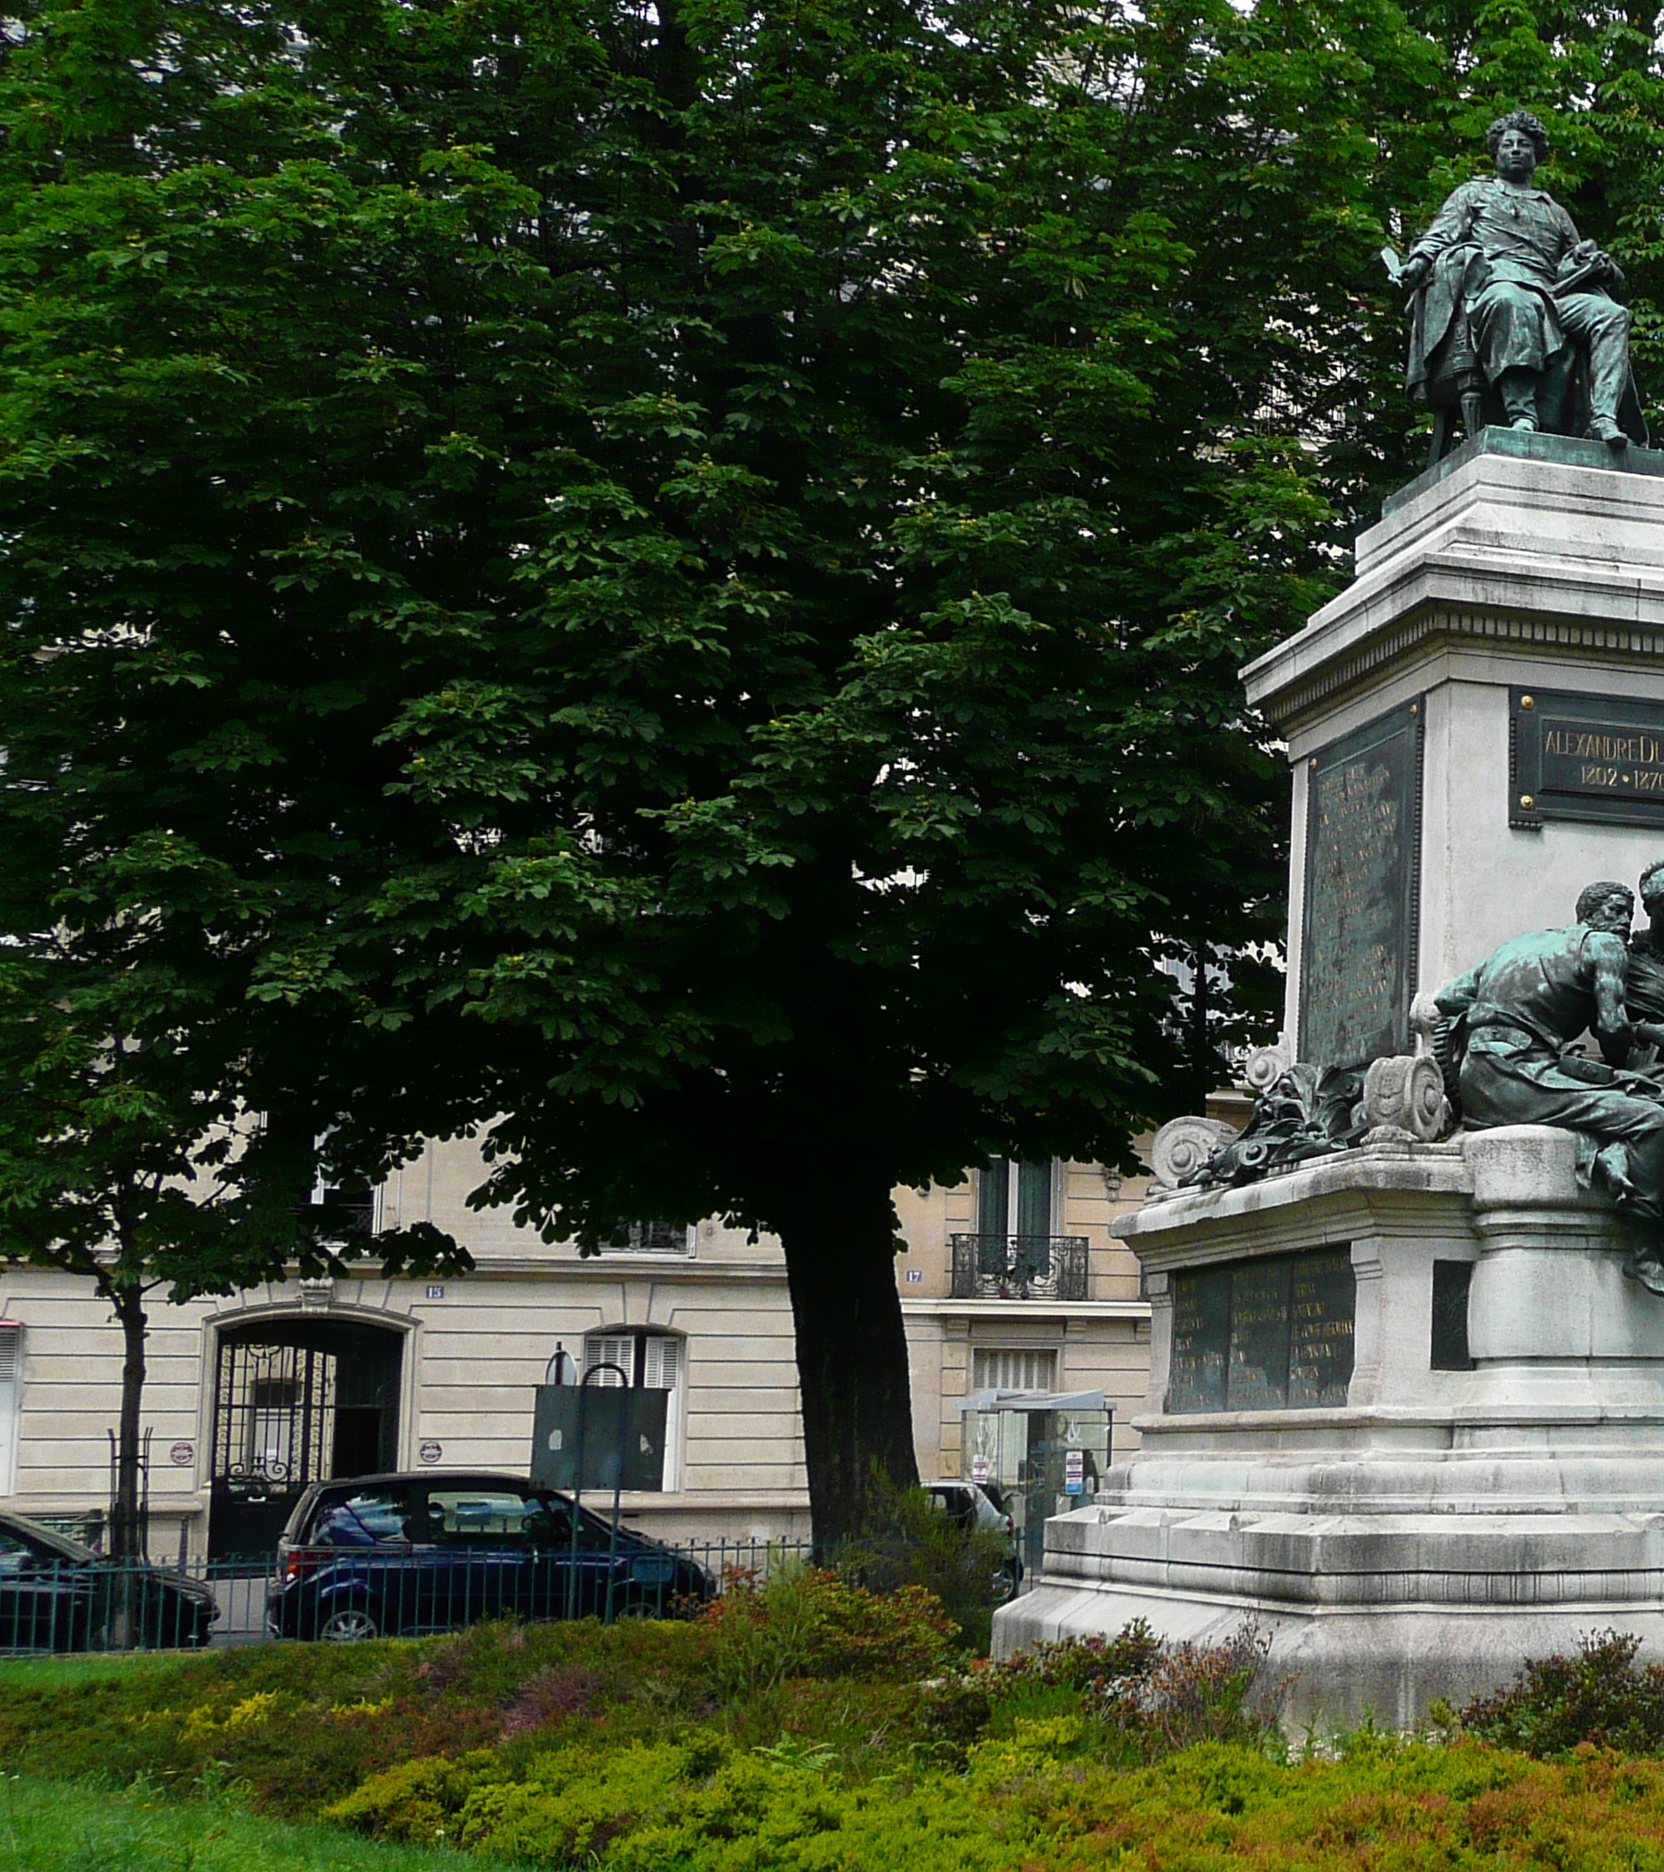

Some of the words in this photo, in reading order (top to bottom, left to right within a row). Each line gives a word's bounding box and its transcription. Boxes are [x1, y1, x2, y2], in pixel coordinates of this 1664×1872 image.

[1545, 730, 1638, 762] ALEXANDRE
[1581, 765, 1618, 788] 1802
[909, 1271, 920, 1282] 17
